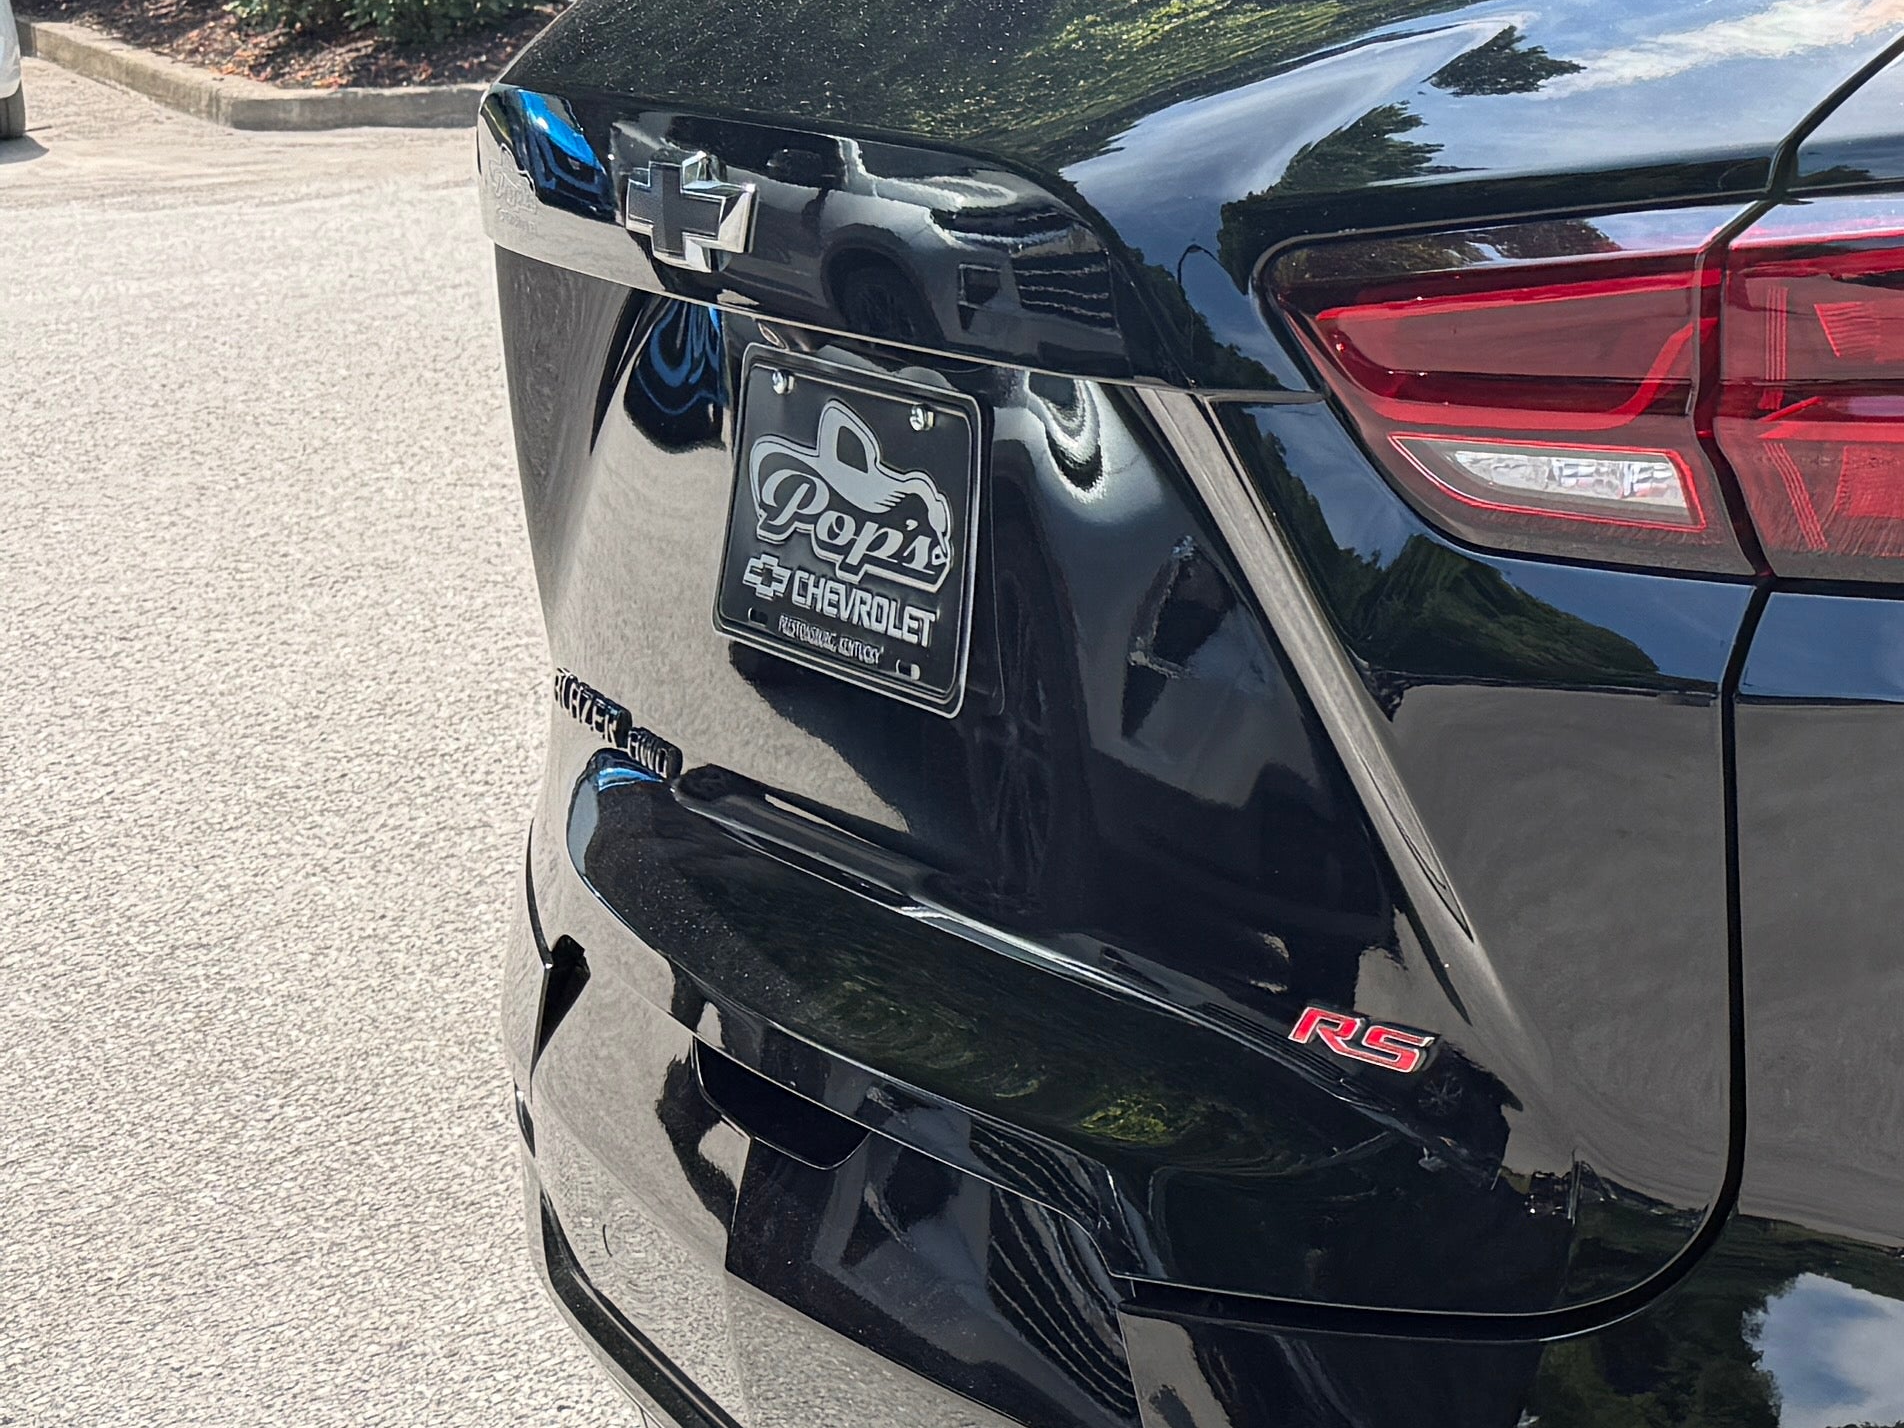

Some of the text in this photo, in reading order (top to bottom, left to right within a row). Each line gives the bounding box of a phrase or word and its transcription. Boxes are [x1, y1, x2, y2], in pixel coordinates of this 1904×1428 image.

[761, 469, 938, 575] Pop's
[792, 570, 939, 648] CHEVROLET
[1288, 1006, 1435, 1073] RS
